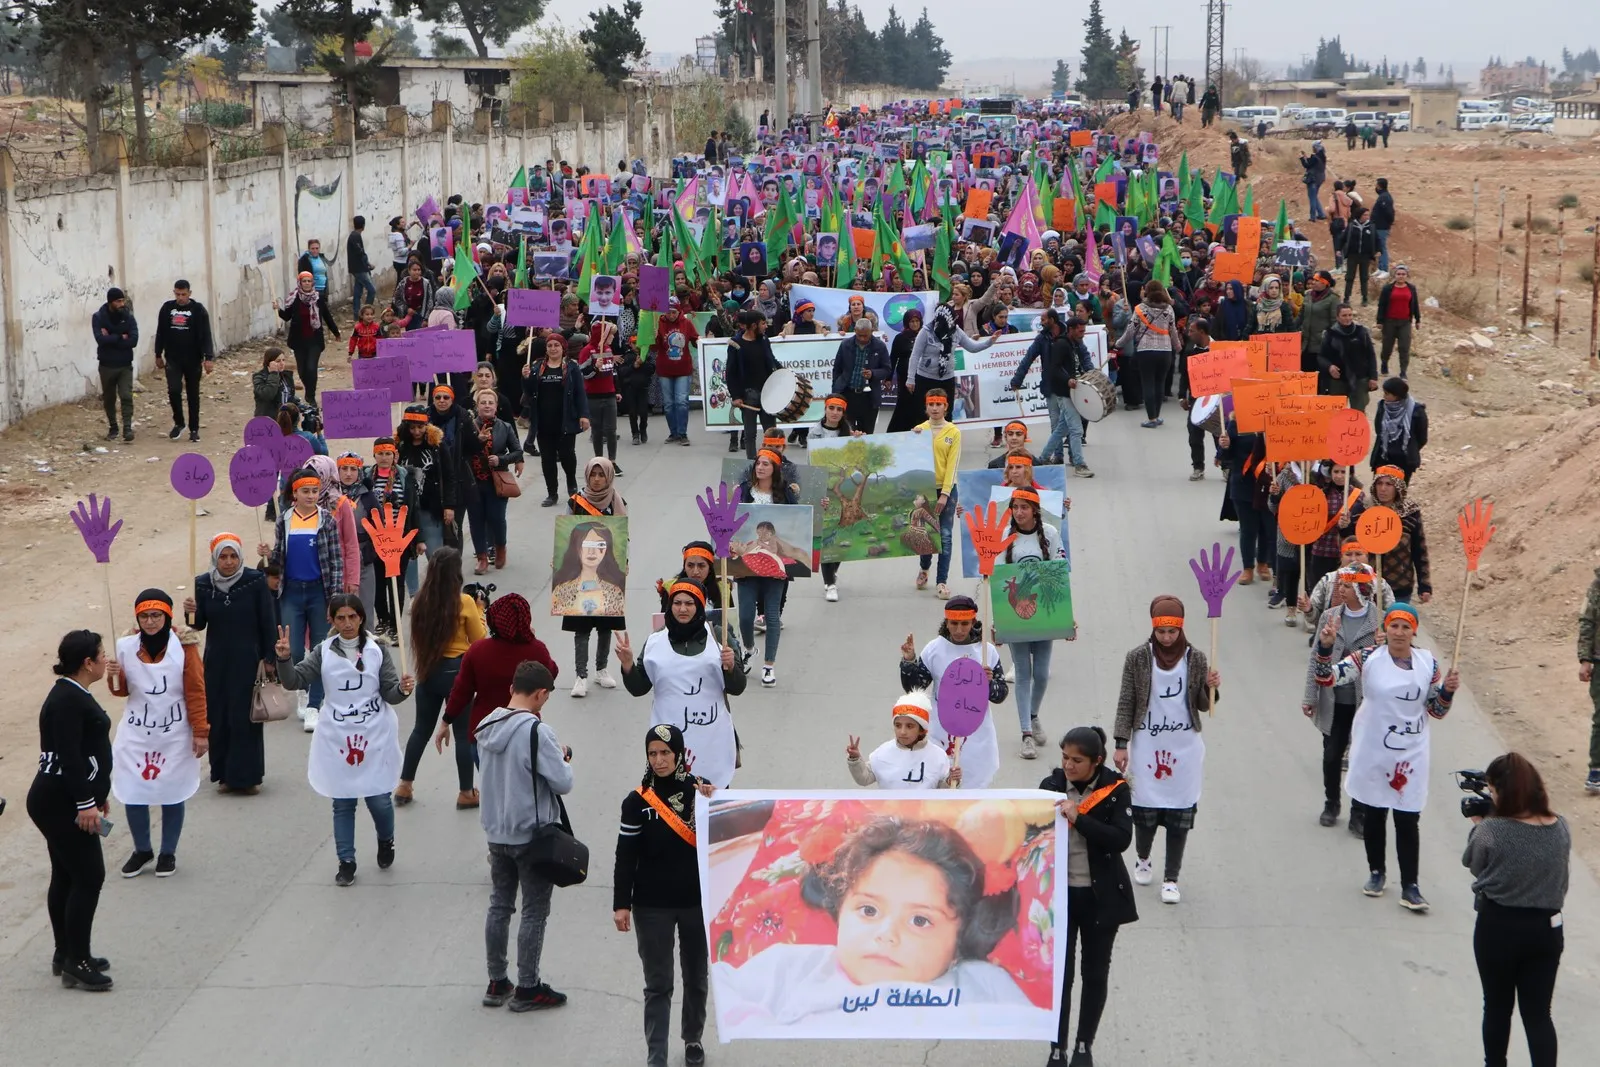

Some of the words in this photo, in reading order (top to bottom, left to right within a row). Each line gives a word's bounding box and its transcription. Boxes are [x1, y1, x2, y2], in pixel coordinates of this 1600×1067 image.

[982, 360, 1012, 369] HEMBER
[1364, 516, 1394, 538] المرأة
[145, 675, 168, 695] لا
[338, 674, 363, 691] لا
[683, 678, 702, 696] لا
[1159, 677, 1182, 698] لا
[1395, 686, 1421, 702] لا
[954, 697, 982, 714] حياة
[902, 761, 926, 784] لا
[842, 988, 880, 1014] لين
[887, 988, 962, 1008] الطفلة
